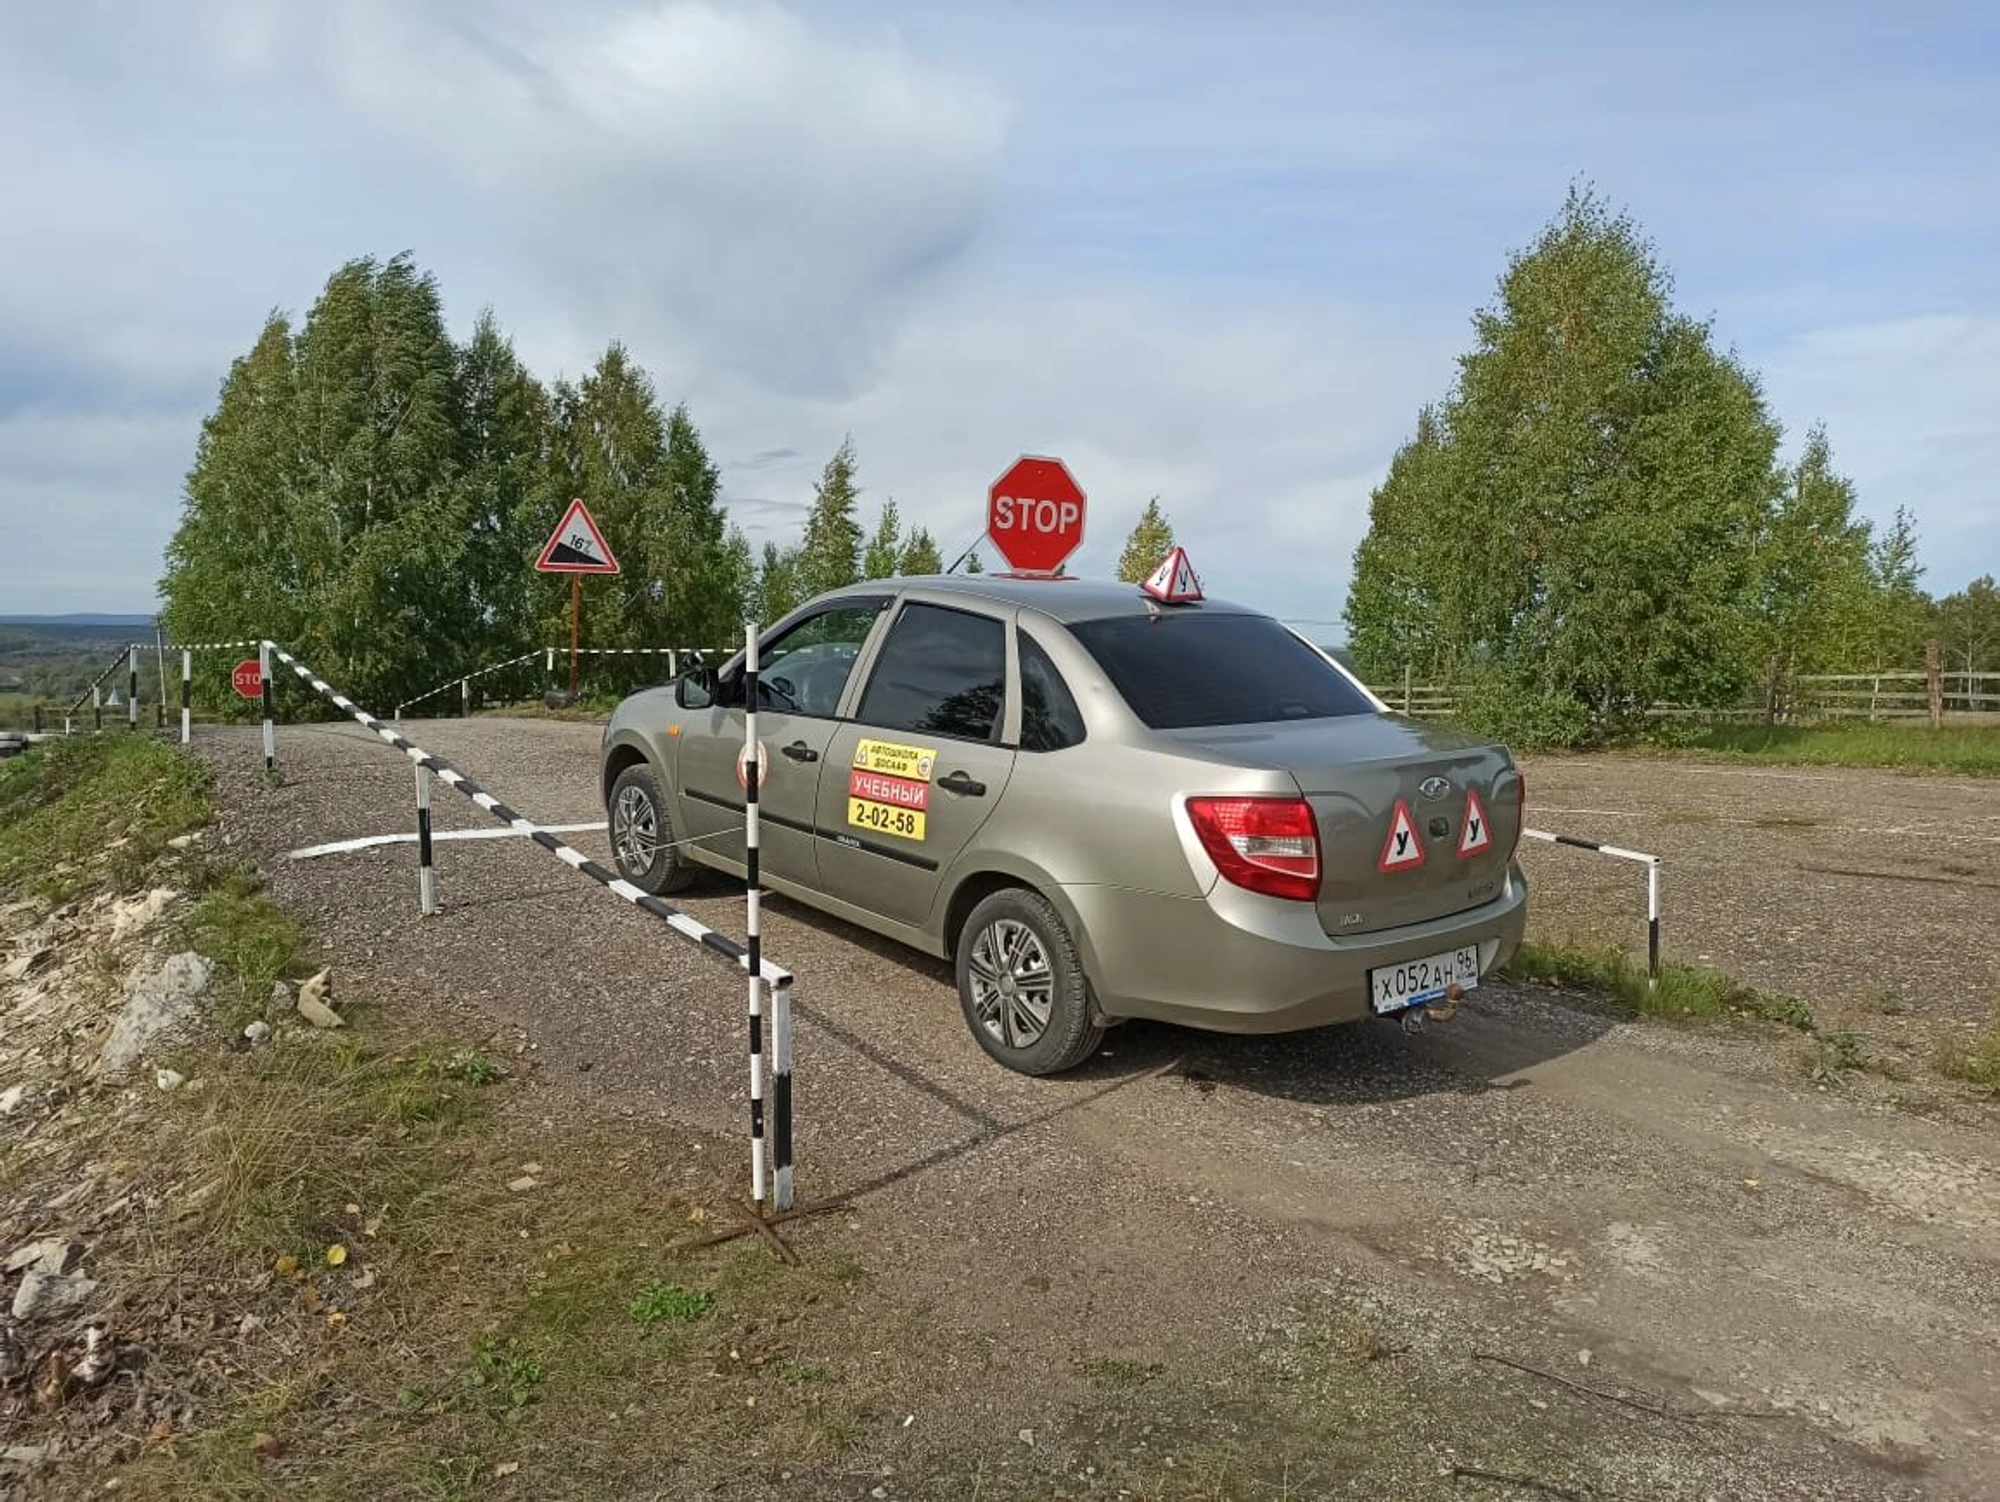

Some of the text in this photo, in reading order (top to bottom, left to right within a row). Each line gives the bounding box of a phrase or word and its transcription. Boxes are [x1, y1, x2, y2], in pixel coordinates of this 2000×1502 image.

[995, 496, 1079, 534] STOP
[235, 672, 262, 685] STO
[854, 775, 924, 804] УЧЕБНЫЙ
[856, 803, 915, 834] 2-02-58
[1470, 818, 1480, 842] У
[1396, 830, 1409, 856] У
